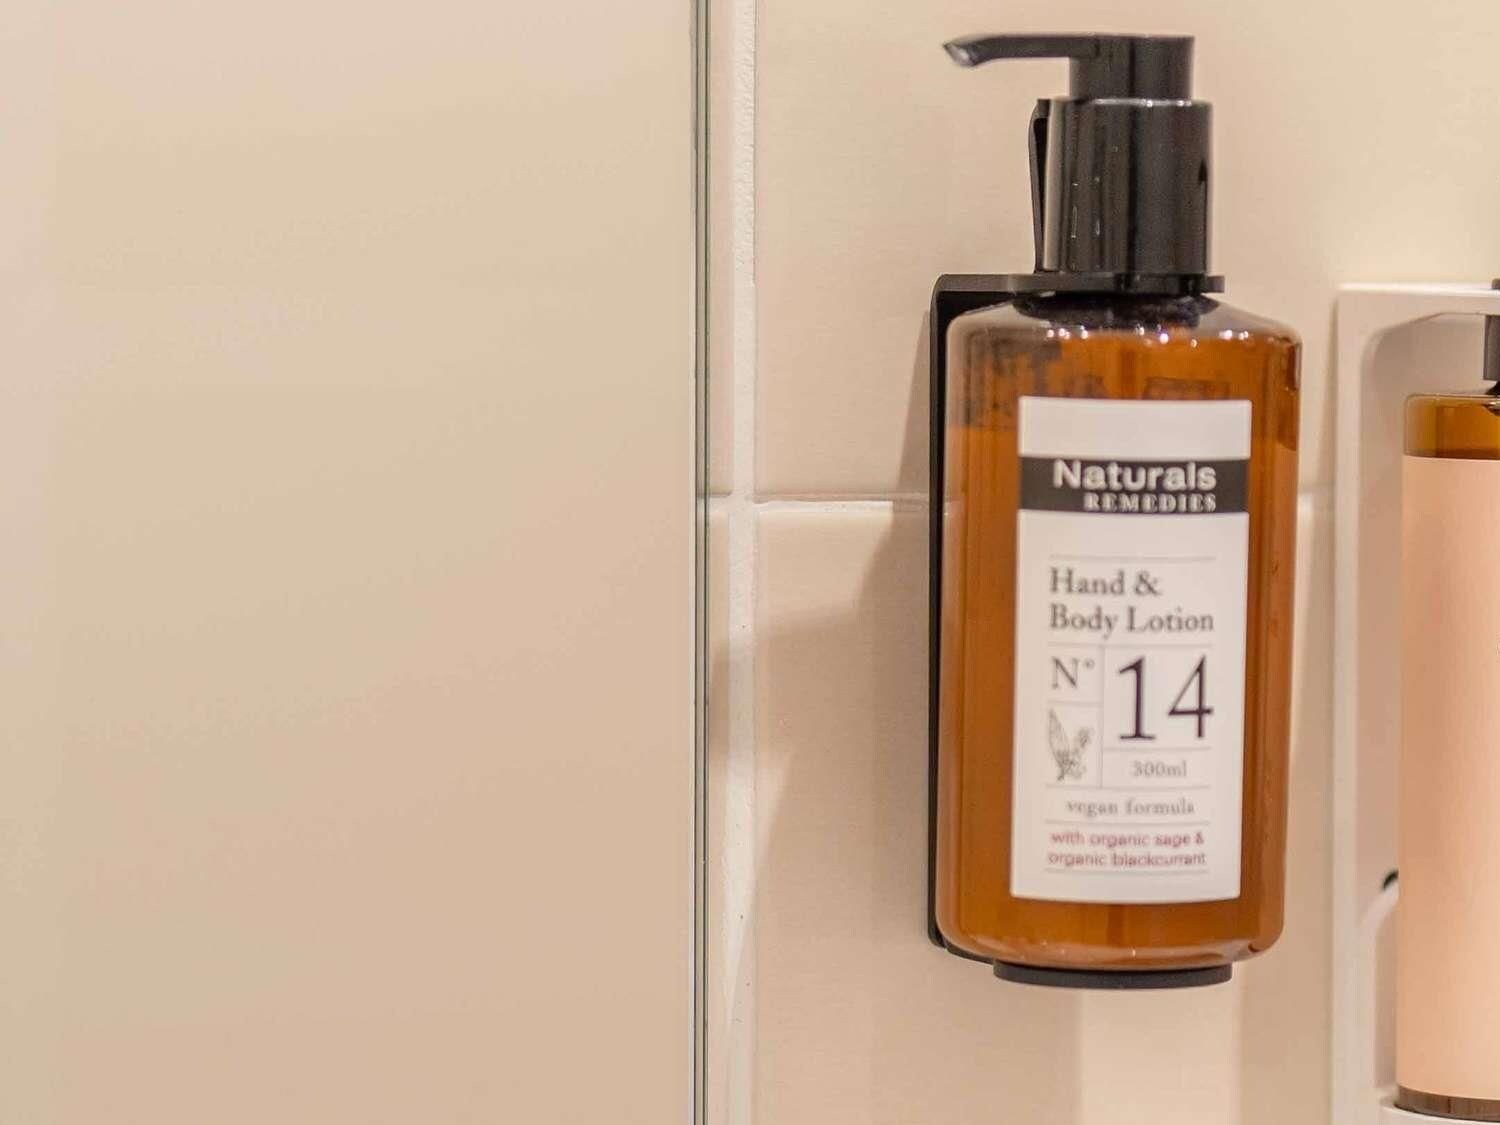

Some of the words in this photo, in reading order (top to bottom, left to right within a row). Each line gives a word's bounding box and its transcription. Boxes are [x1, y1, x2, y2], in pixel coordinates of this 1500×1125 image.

[1053, 459, 1217, 491] Naturals
[1083, 492, 1217, 512] REMEDIES
[1050, 568, 1125, 596] Hand
[1134, 571, 1162, 596] &
[1050, 603, 1118, 639] Body
[1126, 606, 1214, 634] Lotion
[1118, 654, 1214, 741] 14
[1132, 761, 1187, 778] 300ml
[1066, 800, 1118, 817] vegan
[1125, 798, 1195, 815] formula
[1051, 831, 1084, 845] with
[1089, 832, 1148, 849] organic
[1155, 833, 1190, 849] sage
[1048, 854, 1104, 868] organic
[1113, 853, 1206, 867] blackcurrant
